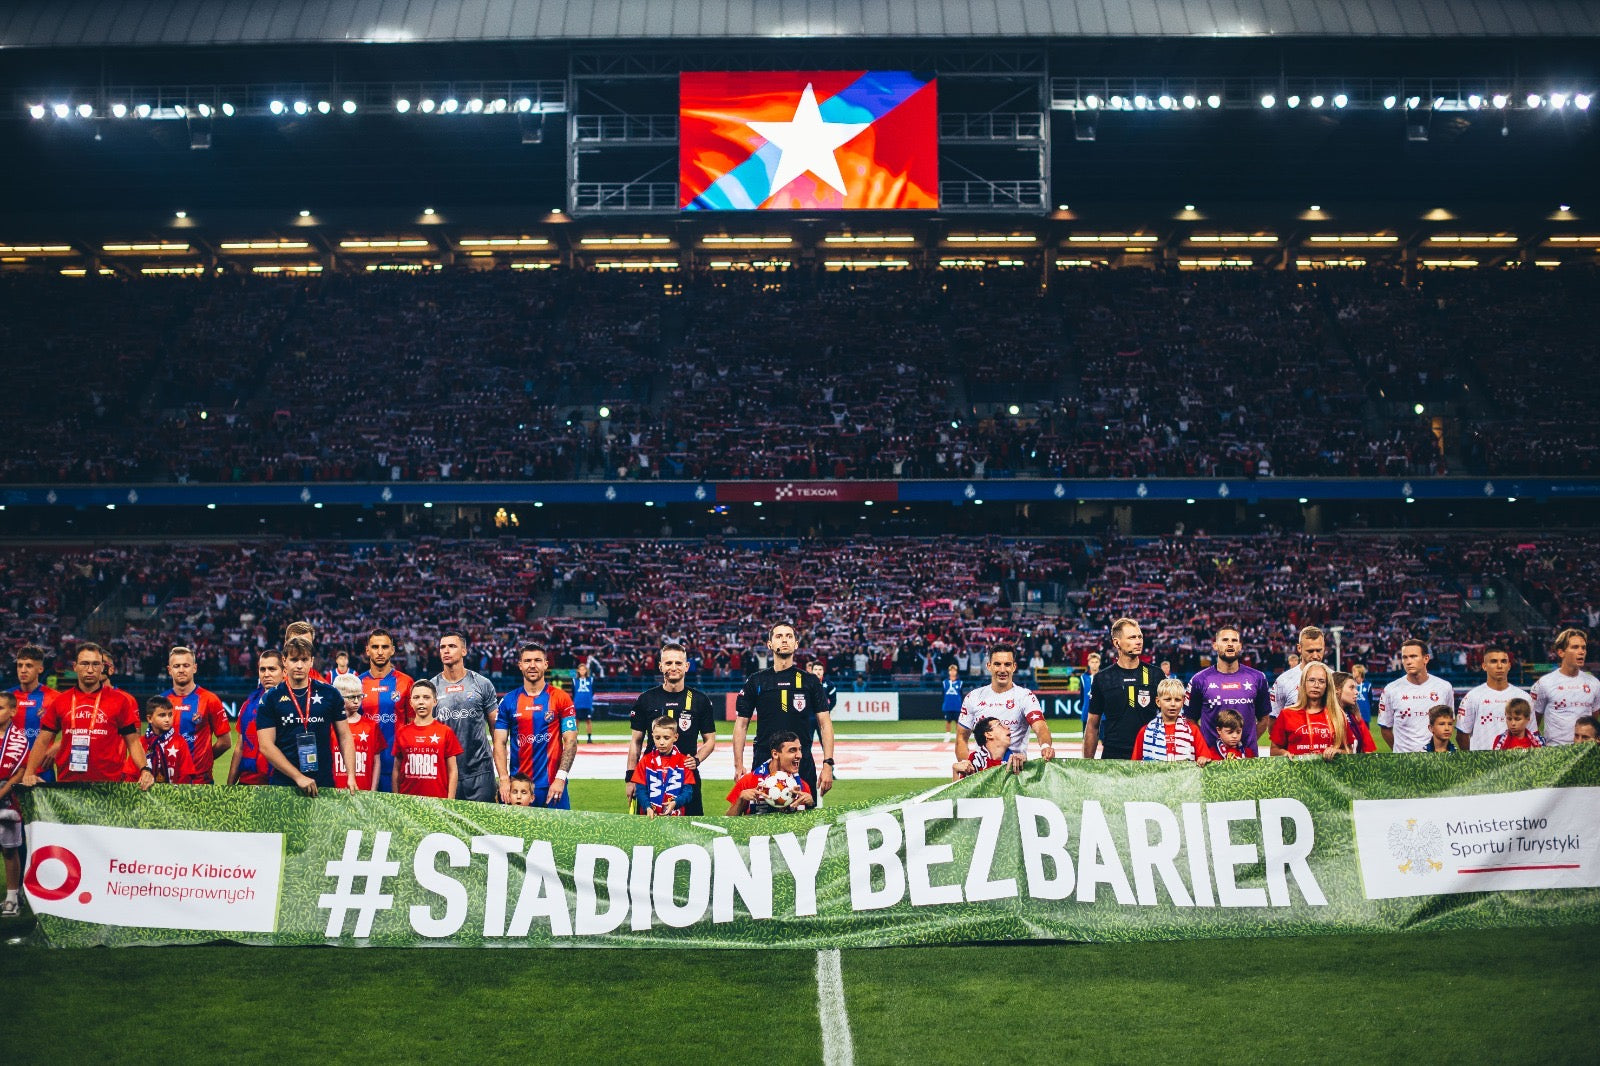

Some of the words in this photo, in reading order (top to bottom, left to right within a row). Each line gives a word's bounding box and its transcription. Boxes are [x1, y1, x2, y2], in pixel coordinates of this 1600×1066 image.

[796, 488, 838, 496] TEXOM
[844, 700, 850, 712] 1
[858, 700, 890, 712] LIGA
[1446, 816, 1548, 836] Ministerstwo
[846, 797, 1019, 911] BEZ
[1015, 795, 1329, 906] BARIER
[1450, 840, 1505, 858] Sportu
[1508, 838, 1513, 852] i
[1516, 835, 1580, 853] Turystyki
[109, 859, 188, 880] Federacja
[192, 863, 256, 879] Kibiców
[107, 881, 255, 904] Niepełnosprawnych
